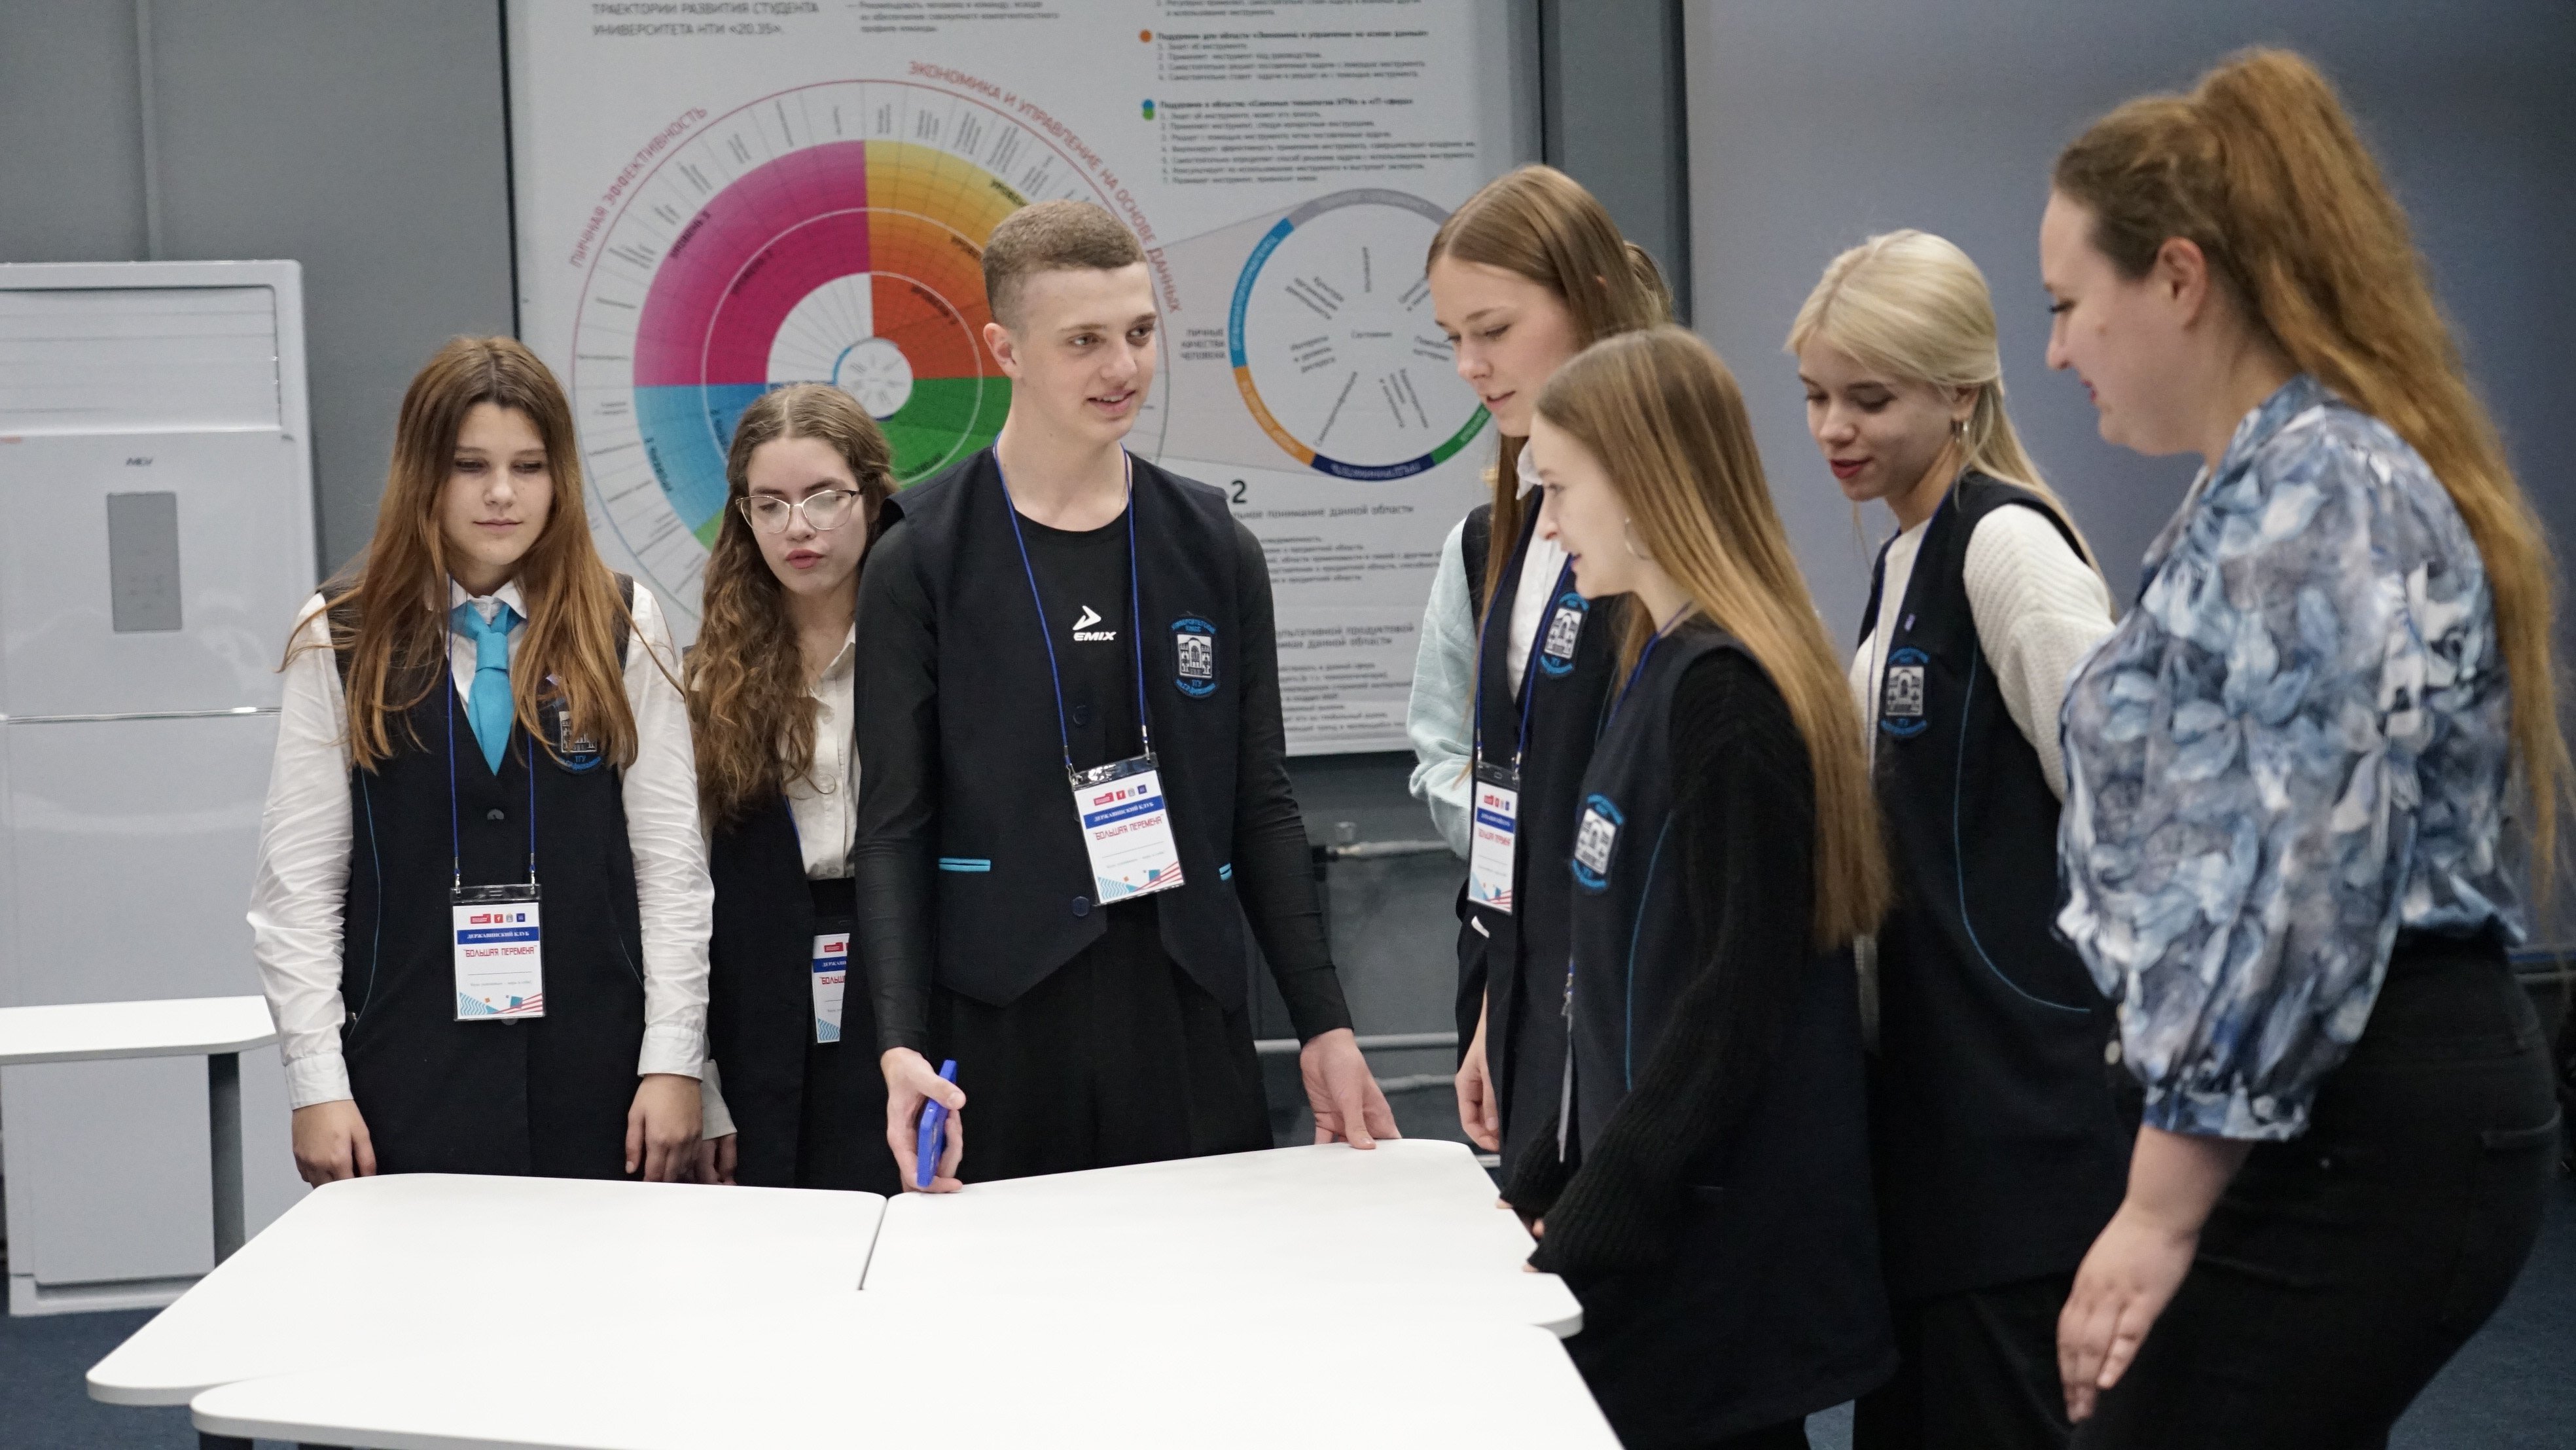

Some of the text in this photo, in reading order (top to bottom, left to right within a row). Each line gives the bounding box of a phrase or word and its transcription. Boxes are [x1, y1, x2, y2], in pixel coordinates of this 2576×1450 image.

[592, 2, 819, 15] ТРАЕКТОРИИ РАЗВИТИЯ СТУДЕНТА
[592, 24, 694, 35] УНИВЕРСИТЕТА
[697, 24, 725, 34] НТИ
[569, 205, 609, 268] ЛИЧНАЯ
[602, 107, 707, 205] ЭФФЕКТИВНОСТЬ
[909, 60, 1001, 99] ЭКОНОМИКА
[1004, 92, 1017, 106] И
[1018, 100, 1103, 171] УПРАВЛЕНИЕ
[1099, 168, 1118, 190] НА
[1115, 188, 1157, 244] ОСНОВЕ
[1146, 247, 1182, 313] ДАННЫХ
[1231, 480, 1247, 504] 2
[1073, 631, 1117, 641] EMIX
[1139, 802, 1154, 811] КЛУБ
[467, 931, 514, 940] ДЕРЖАВИНСКИЙ
